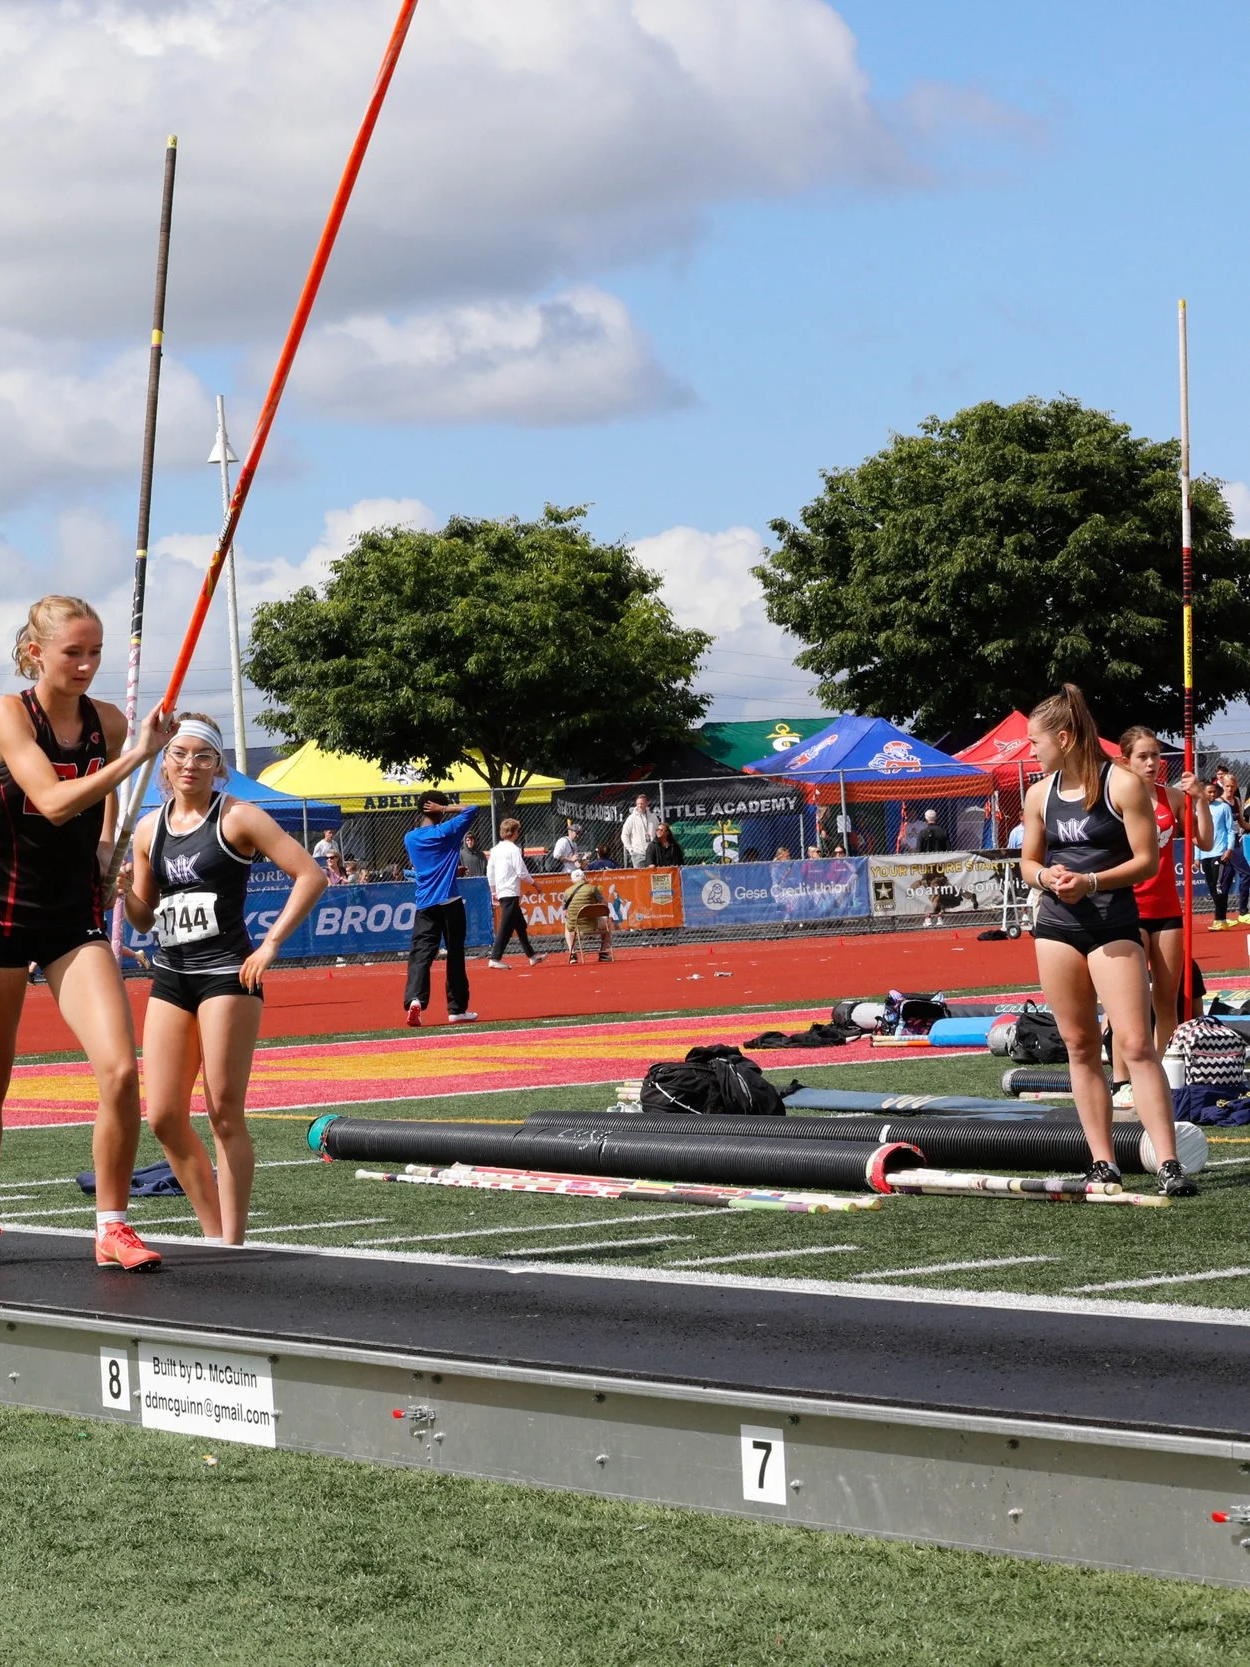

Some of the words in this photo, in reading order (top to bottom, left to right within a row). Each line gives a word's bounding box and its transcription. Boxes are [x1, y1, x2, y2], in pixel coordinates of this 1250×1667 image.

[364, 793, 460, 810] ABERN
[711, 797, 797, 815] ACADEMY
[1056, 816, 1090, 842] NK
[164, 852, 204, 885] NK
[871, 865, 907, 878] YOUR
[911, 862, 962, 876] FUTURE
[520, 893, 547, 905] ACK
[734, 887, 768, 900] Gesa
[770, 882, 811, 898] Credit
[814, 879, 850, 895] Union
[160, 905, 209, 936] 1744
[315, 902, 417, 936] BROO
[108, 1359, 122, 1399] 8
[152, 1356, 177, 1377] Built
[179, 1359, 192, 1384] by
[195, 1362, 206, 1381] D.
[209, 1363, 257, 1388] McGuinn
[145, 1390, 270, 1426] ddmcguinn@gmail.com
[752, 1440, 772, 1489] 7
